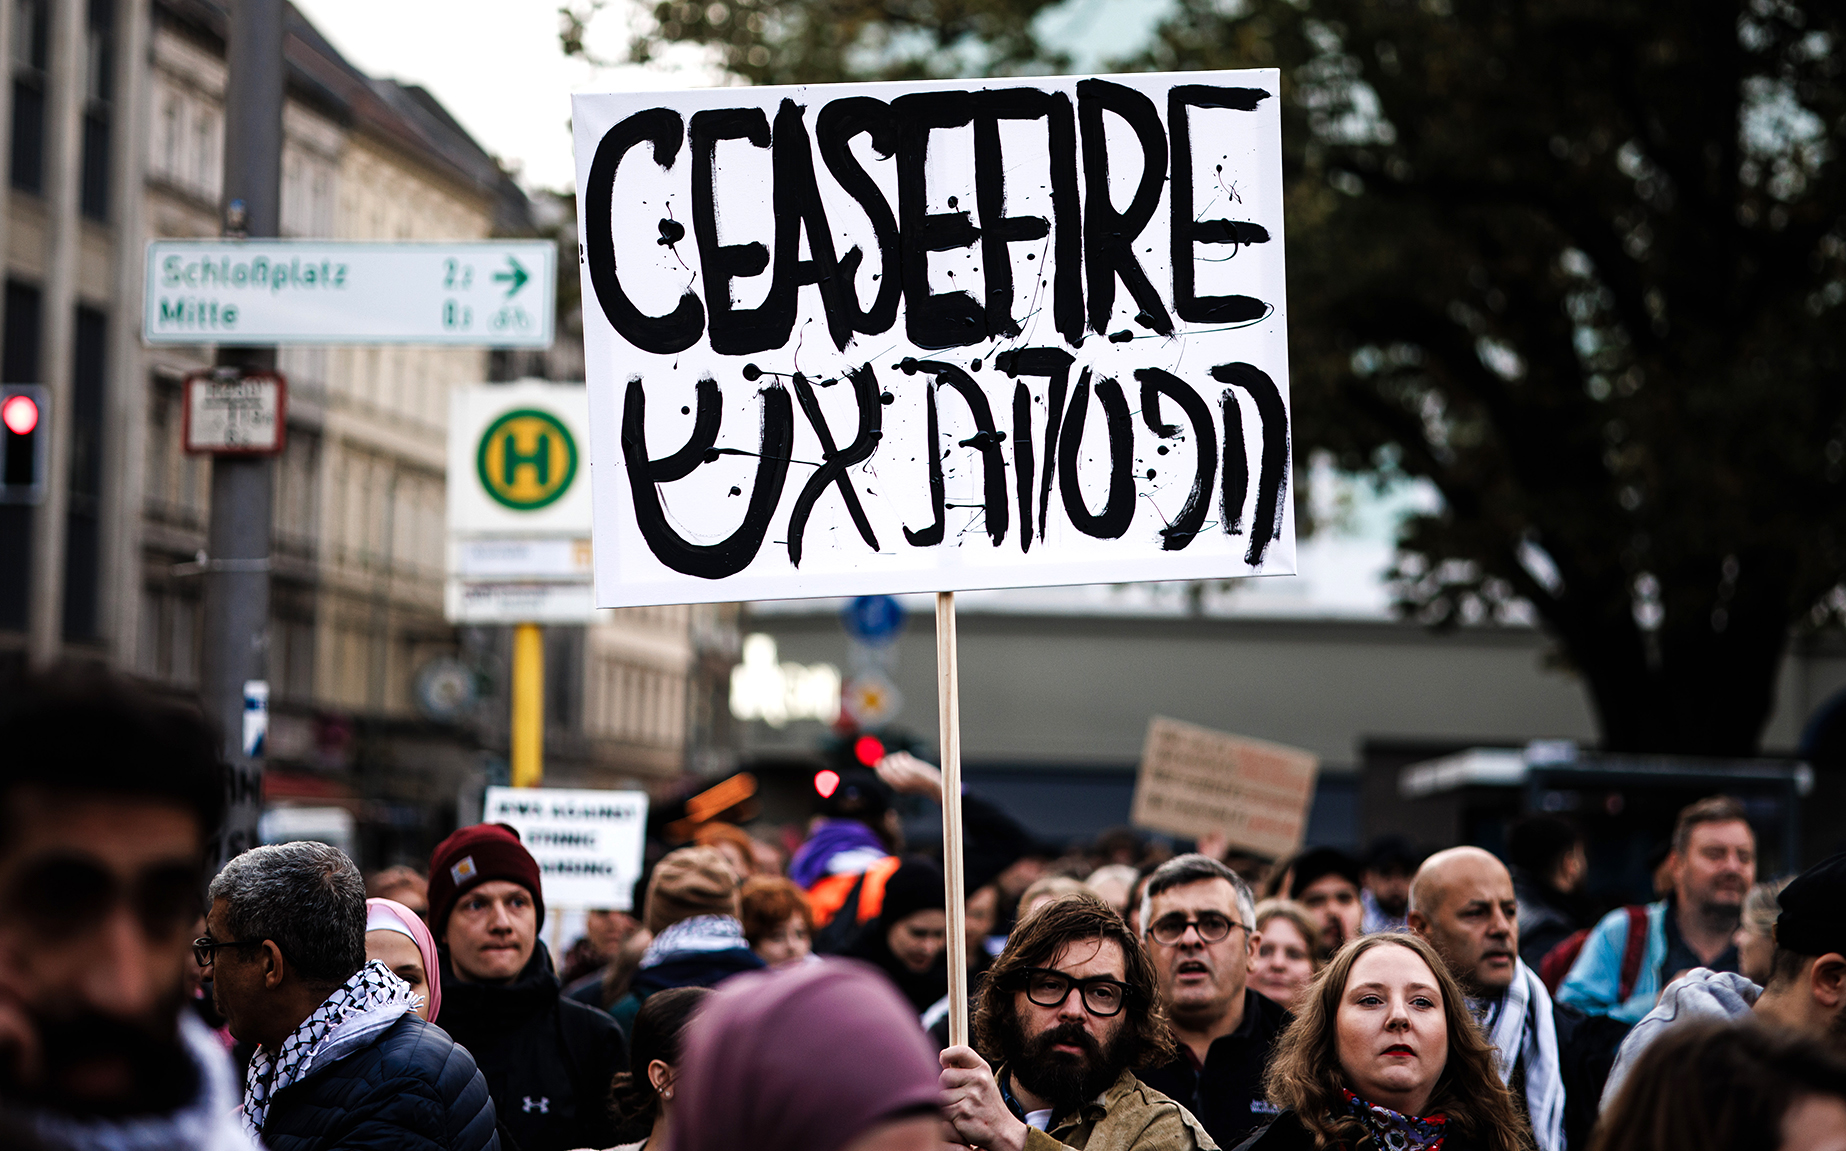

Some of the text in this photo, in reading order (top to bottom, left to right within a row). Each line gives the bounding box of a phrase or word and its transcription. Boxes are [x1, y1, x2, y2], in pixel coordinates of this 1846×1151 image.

[585, 77, 1272, 356] CEASEFIRE
[161, 254, 349, 297] Schloßplatz
[158, 296, 240, 330] Mitte
[504, 433, 550, 487] H
[621, 347, 1290, 580] הפסקת אש
